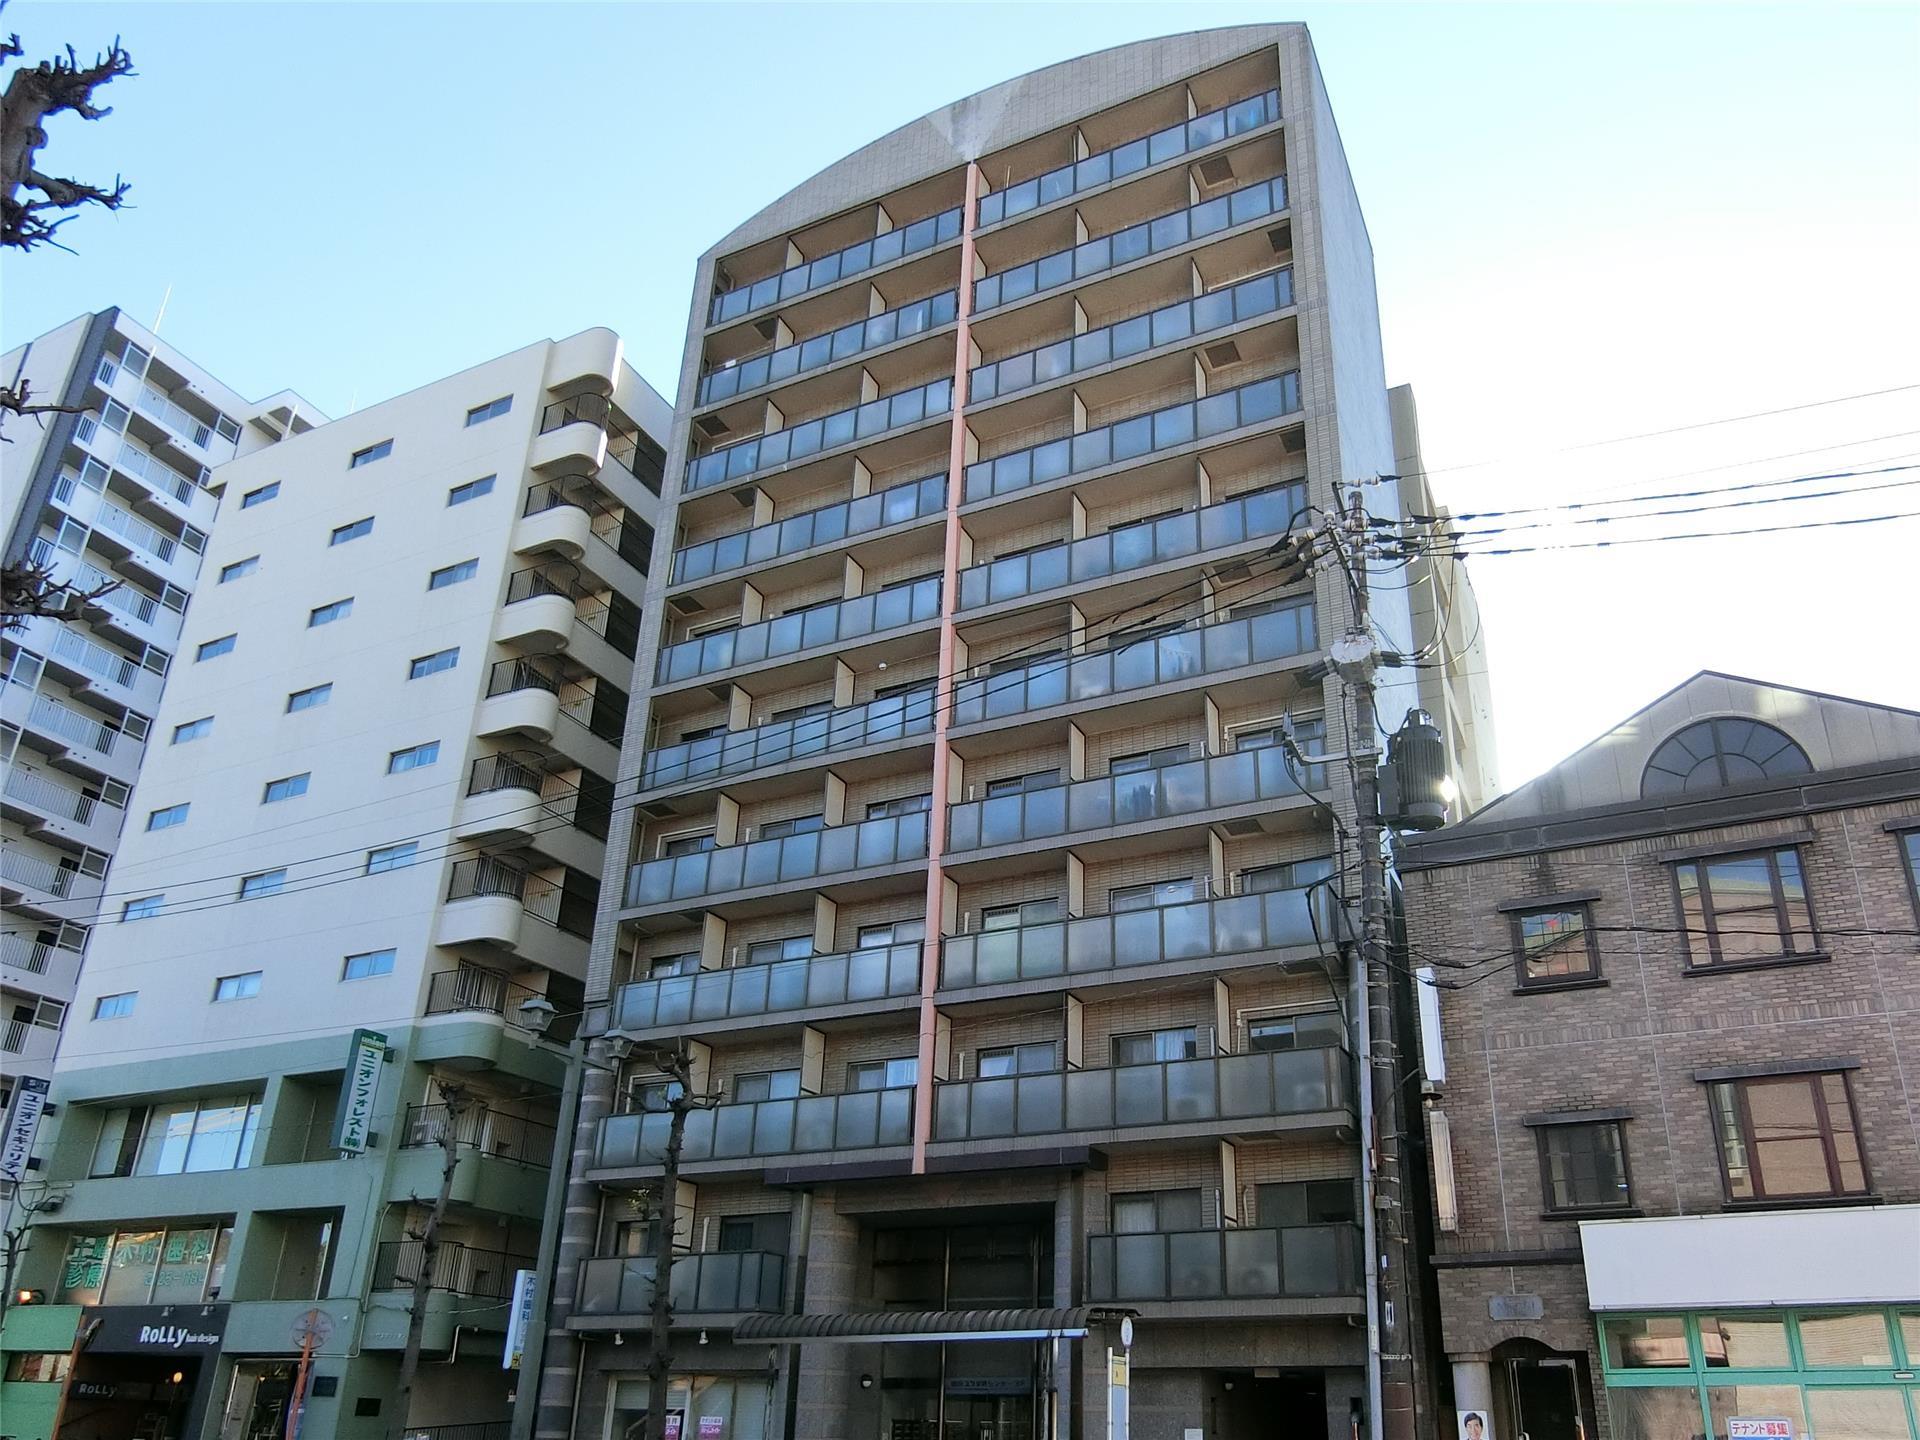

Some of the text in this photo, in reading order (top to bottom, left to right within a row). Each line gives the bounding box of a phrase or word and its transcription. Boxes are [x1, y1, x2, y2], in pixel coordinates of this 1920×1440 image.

[1732, 1423, 1789, 1435] テナント募集
